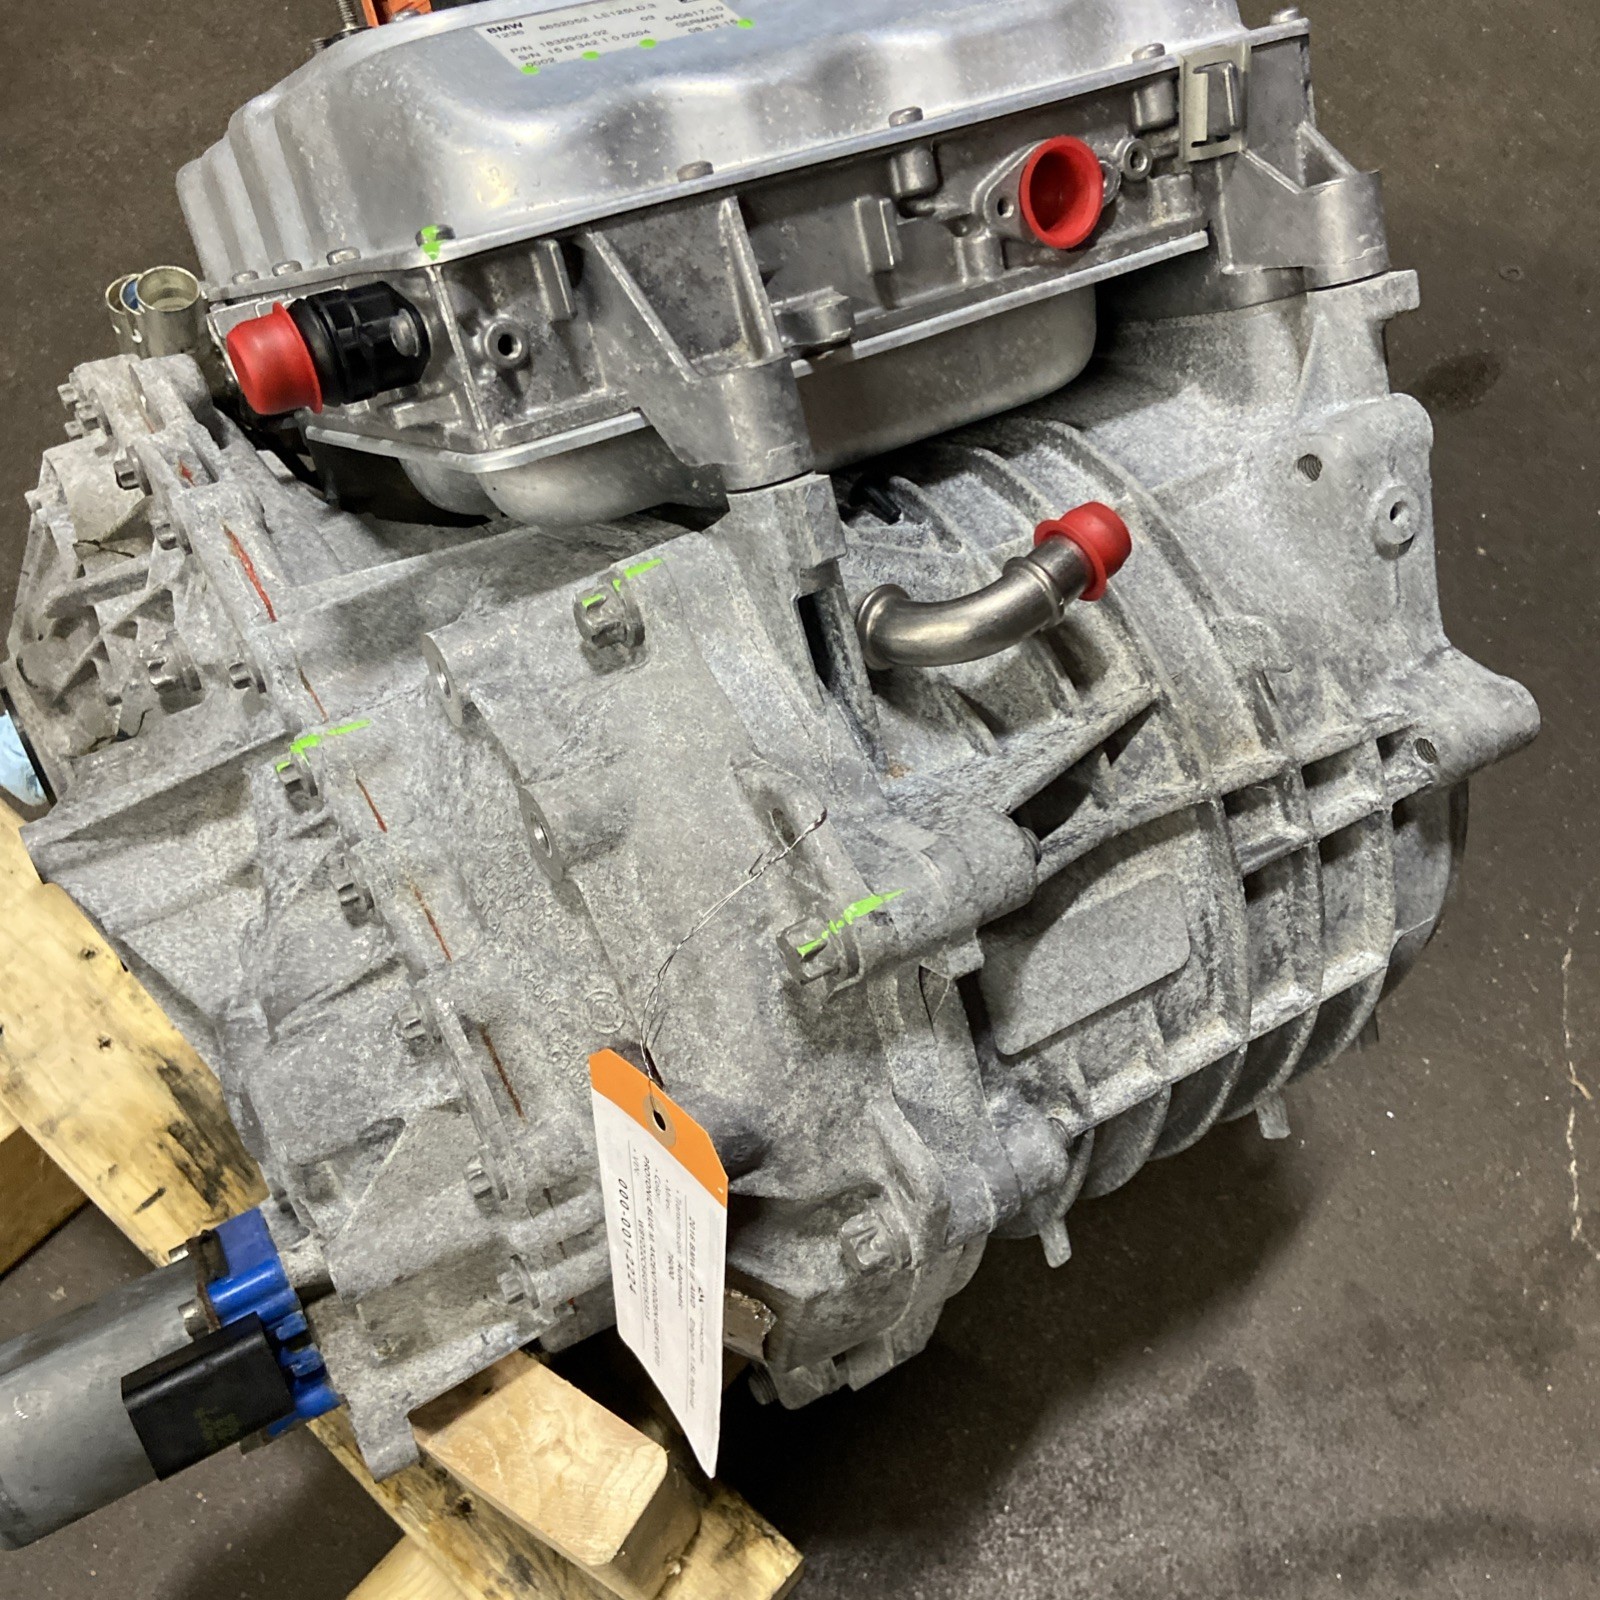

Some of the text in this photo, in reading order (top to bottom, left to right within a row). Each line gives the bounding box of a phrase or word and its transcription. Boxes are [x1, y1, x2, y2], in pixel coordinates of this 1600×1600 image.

[675, 14, 724, 28] GERMANY
[486, 22, 524, 34] BMW
[510, 45, 534, 54] P/N
[518, 52, 541, 61] S/N
[643, 1155, 652, 1206] PROTONIC
[618, 1178, 637, 1295] 000-001-2224
